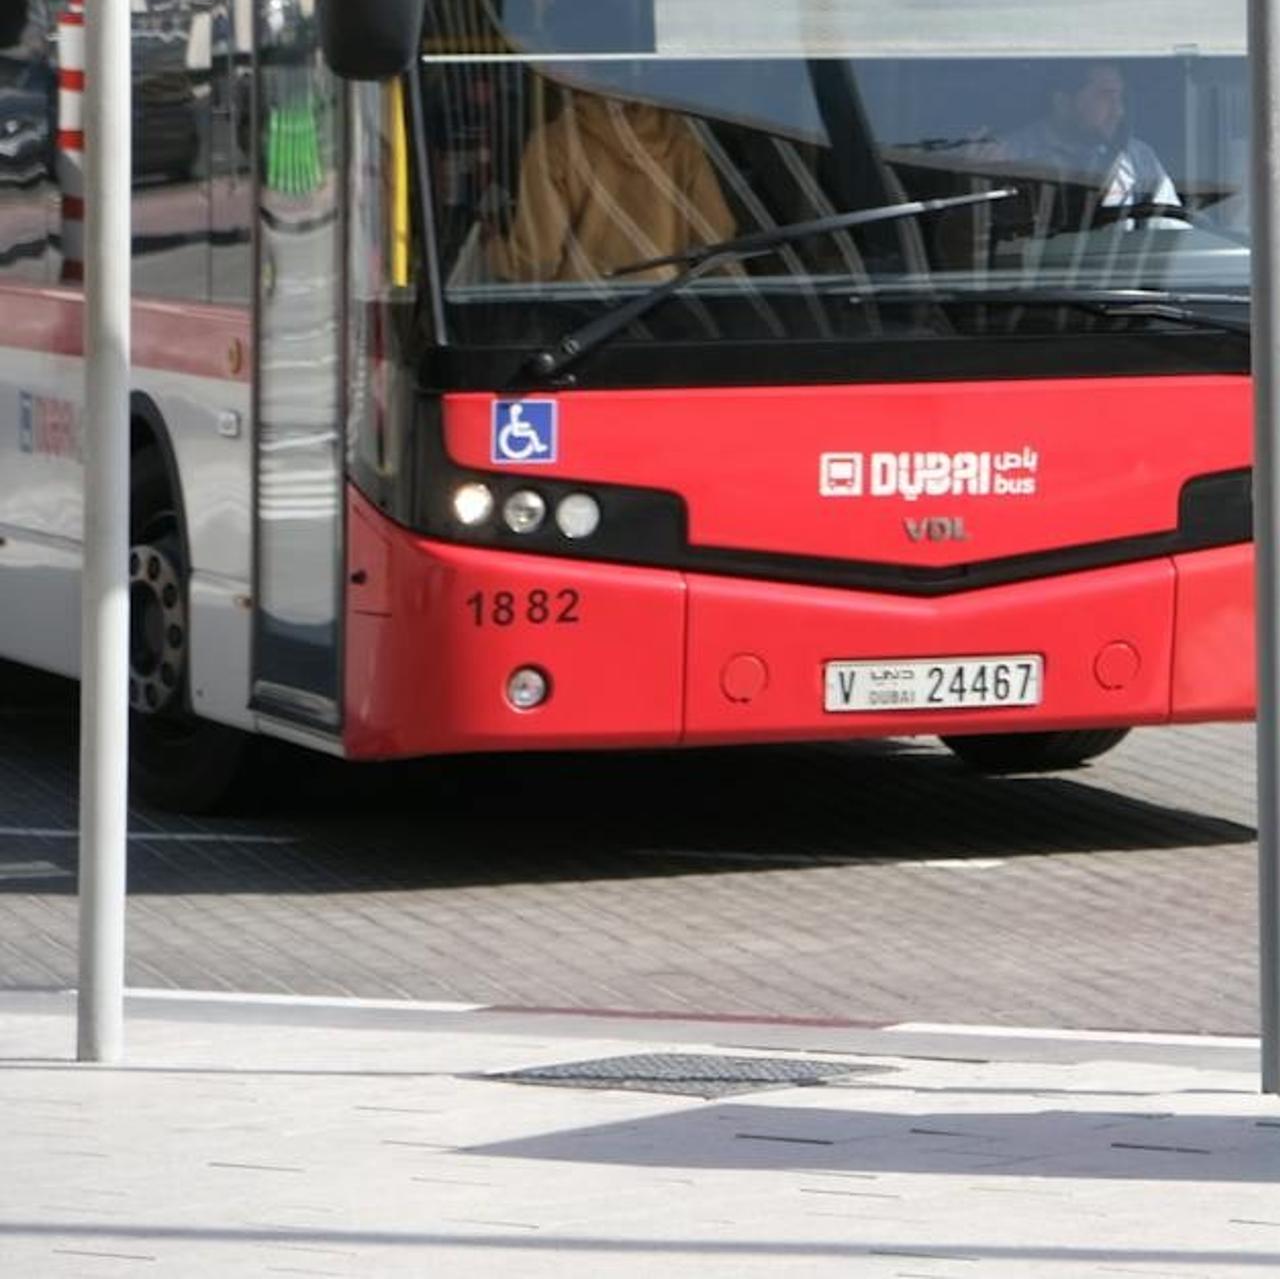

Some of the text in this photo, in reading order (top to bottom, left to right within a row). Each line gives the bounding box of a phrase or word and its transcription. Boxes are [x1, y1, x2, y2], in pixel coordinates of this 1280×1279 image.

[870, 451, 991, 501] DUBAI
[993, 475, 1036, 496] bus
[904, 516, 972, 543] VDL
[466, 588, 581, 627] 1882
[838, 670, 856, 705] V
[927, 663, 1034, 704] 24467
